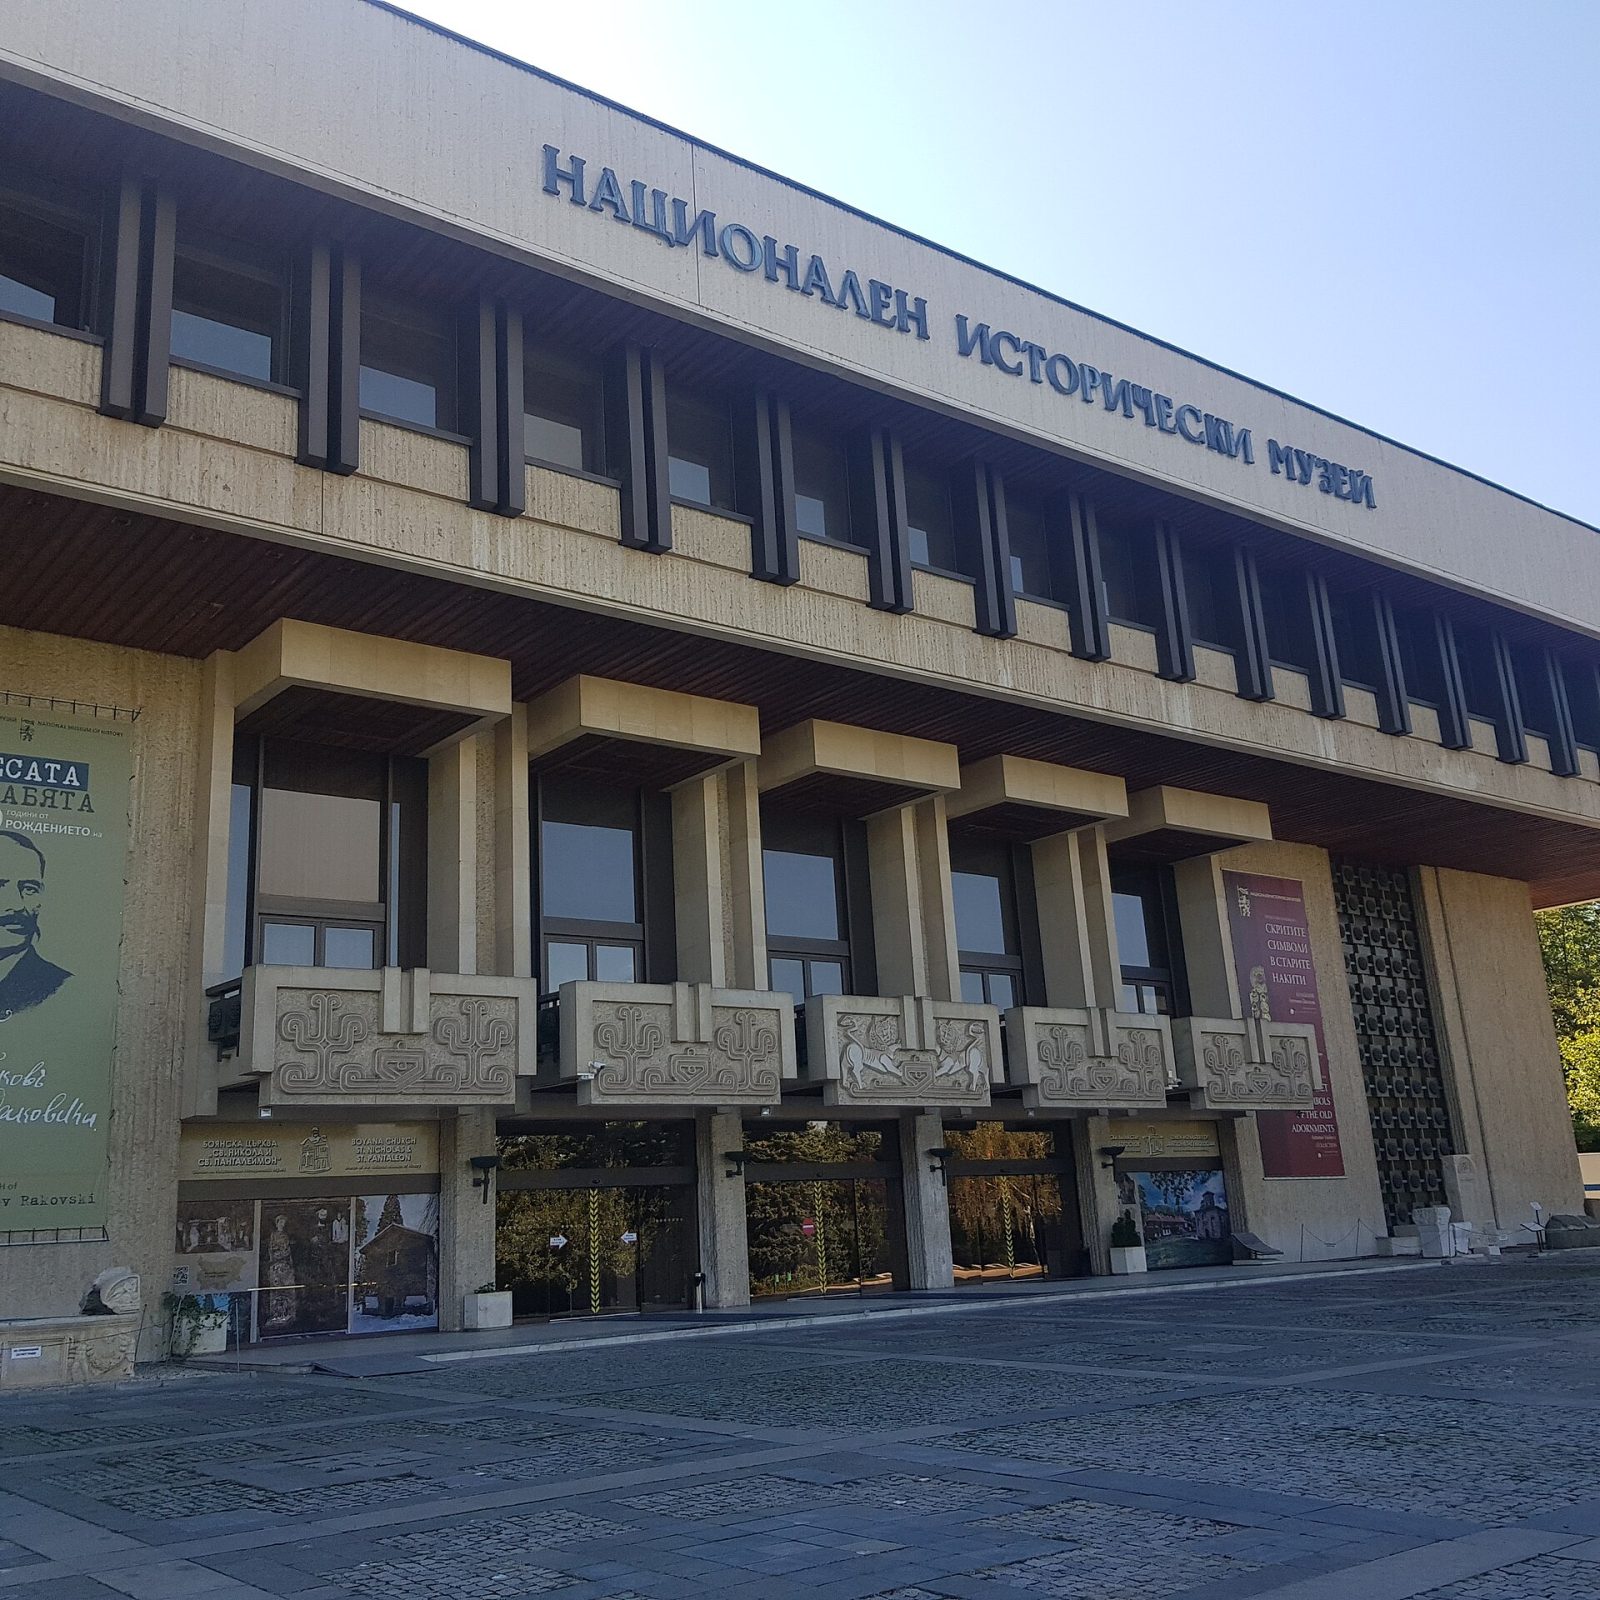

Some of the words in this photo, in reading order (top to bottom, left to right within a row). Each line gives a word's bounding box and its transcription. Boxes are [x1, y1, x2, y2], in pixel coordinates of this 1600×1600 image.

[541, 143, 931, 340] НАЦИОНАЛЕН
[955, 313, 1256, 465] ИСТОРИЧЕСКИ
[1267, 438, 1377, 509] МУЗЕЙ
[5, 819, 91, 836] РОЖДЕНИЕТО
[1265, 922, 1307, 938] СКРИТИТЕ
[1267, 939, 1308, 954] СИМВОЛИ
[1272, 972, 1307, 986] НАКИТИ
[1306, 1110, 1319, 1119] THE
[1319, 1110, 1333, 1119] OLD
[1292, 1123, 1336, 1134] ADORNMENTS
[202, 1140, 242, 1148] БОЯНСКА
[245, 1139, 278, 1148] ЦЪРКВА
[351, 1137, 383, 1146] BOYANA
[385, 1136, 417, 1145] CHURCH
[228, 1148, 264, 1157] НИКОЛА
[265, 1148, 273, 1157] И
[356, 1146, 366, 1154] ST.
[367, 1145, 405, 1154] NICHOLAS
[356, 1155, 367, 1163] ST.
[368, 1153, 412, 1162] PANTALEON
[20, 1192, 96, 1207] Rakovski
